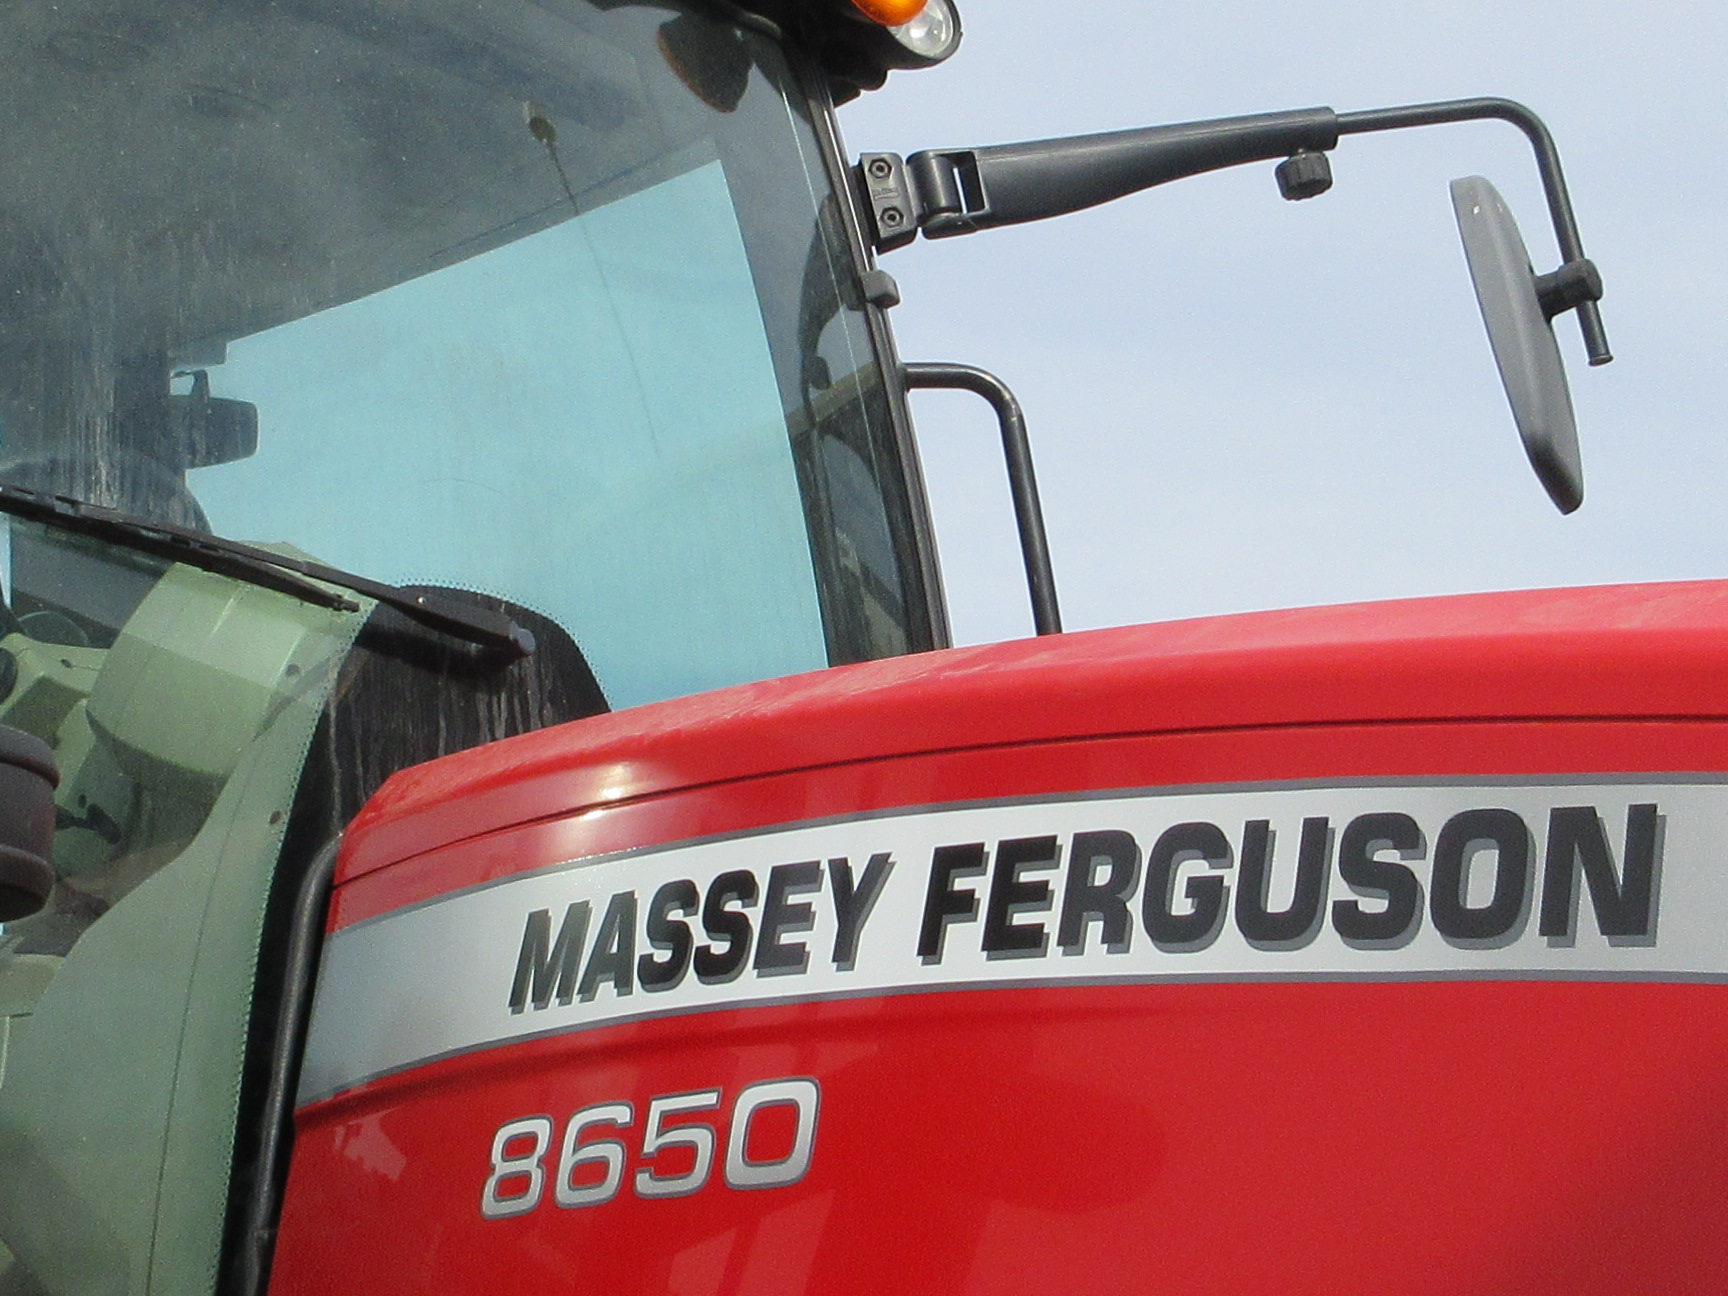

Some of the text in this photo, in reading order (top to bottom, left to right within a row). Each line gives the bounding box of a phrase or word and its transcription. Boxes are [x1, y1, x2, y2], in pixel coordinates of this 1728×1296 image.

[508, 803, 1666, 1015] MASSEY FERGUSON
[480, 1075, 820, 1220] 8650
